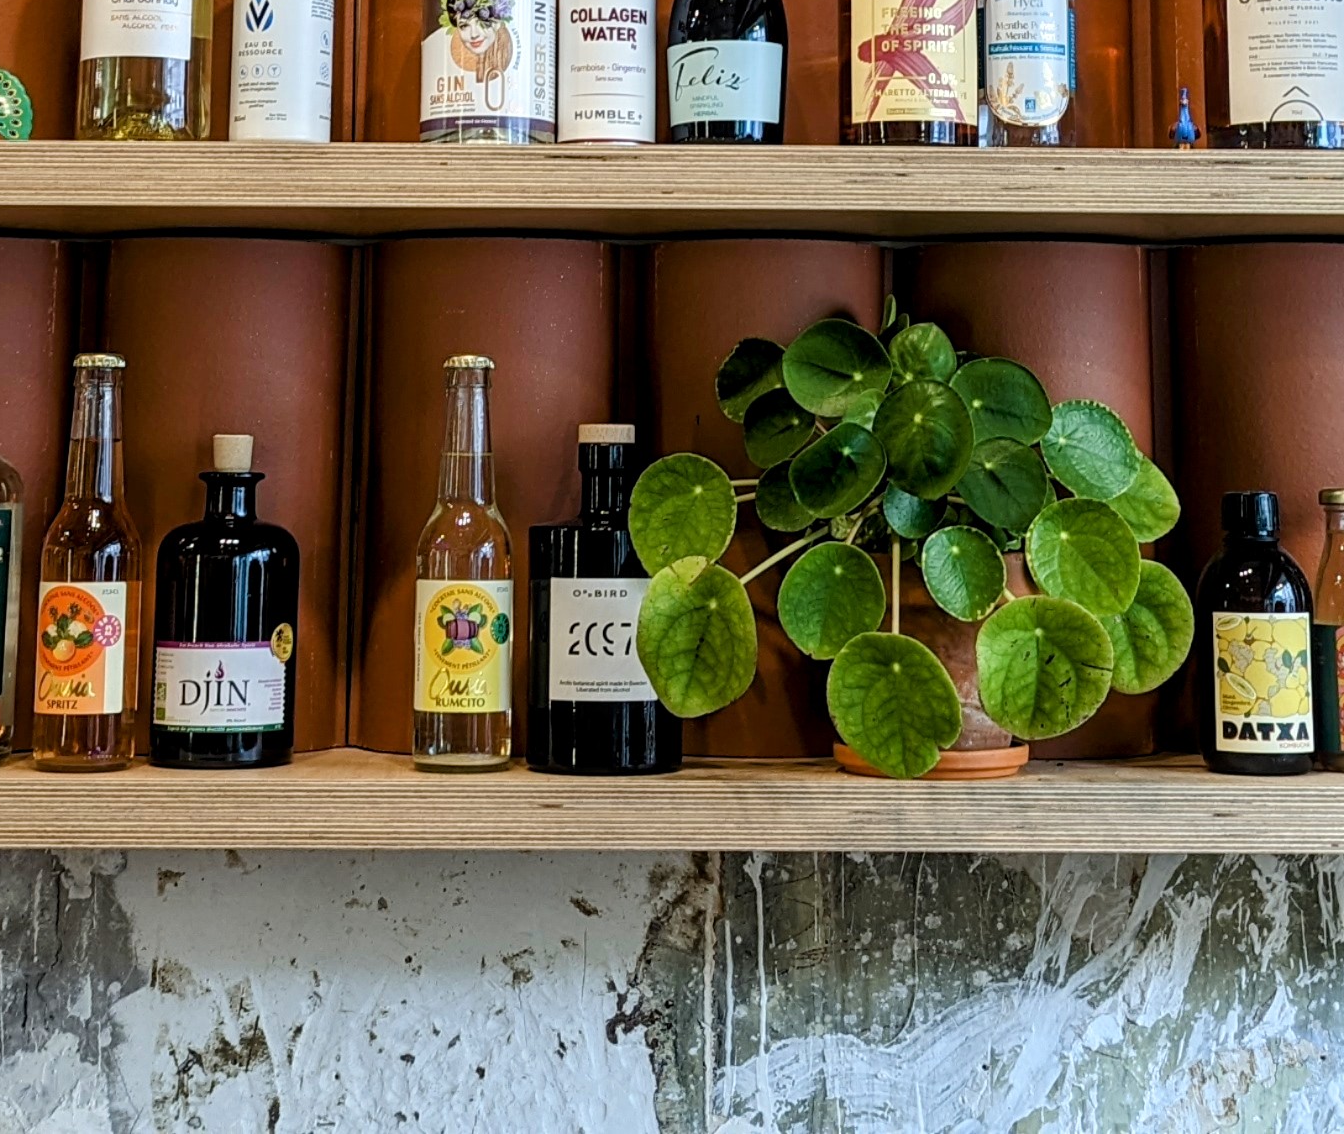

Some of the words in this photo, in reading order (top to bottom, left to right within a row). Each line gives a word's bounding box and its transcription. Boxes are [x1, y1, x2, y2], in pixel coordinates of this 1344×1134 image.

[132, 14, 164, 22] ALCOOL
[570, 7, 648, 26] COLLAGEN
[881, 6, 943, 20] FREEING
[881, 23, 911, 35] THE
[913, 23, 956, 37] SPIRIT
[995, 20, 1030, 30] Menthe
[581, 26, 637, 43] WATER
[1005, 31, 1037, 41] Menthe
[262, 40, 274, 48] DE
[881, 39, 900, 53] OF
[238, 48, 284, 57] RESSOURCE
[570, 63, 606, 74] Framboise
[611, 62, 647, 75] Gingembre
[436, 74, 465, 92] GIN
[928, 72, 958, 86] 0.0%
[429, 94, 446, 107] SANS
[446, 91, 476, 105] ALCOOL
[457, 588, 474, 596] SANS
[46, 699, 78, 710] SPRITZ
[435, 697, 486, 708] RUMCITO
[1222, 720, 1310, 741] DATXA
